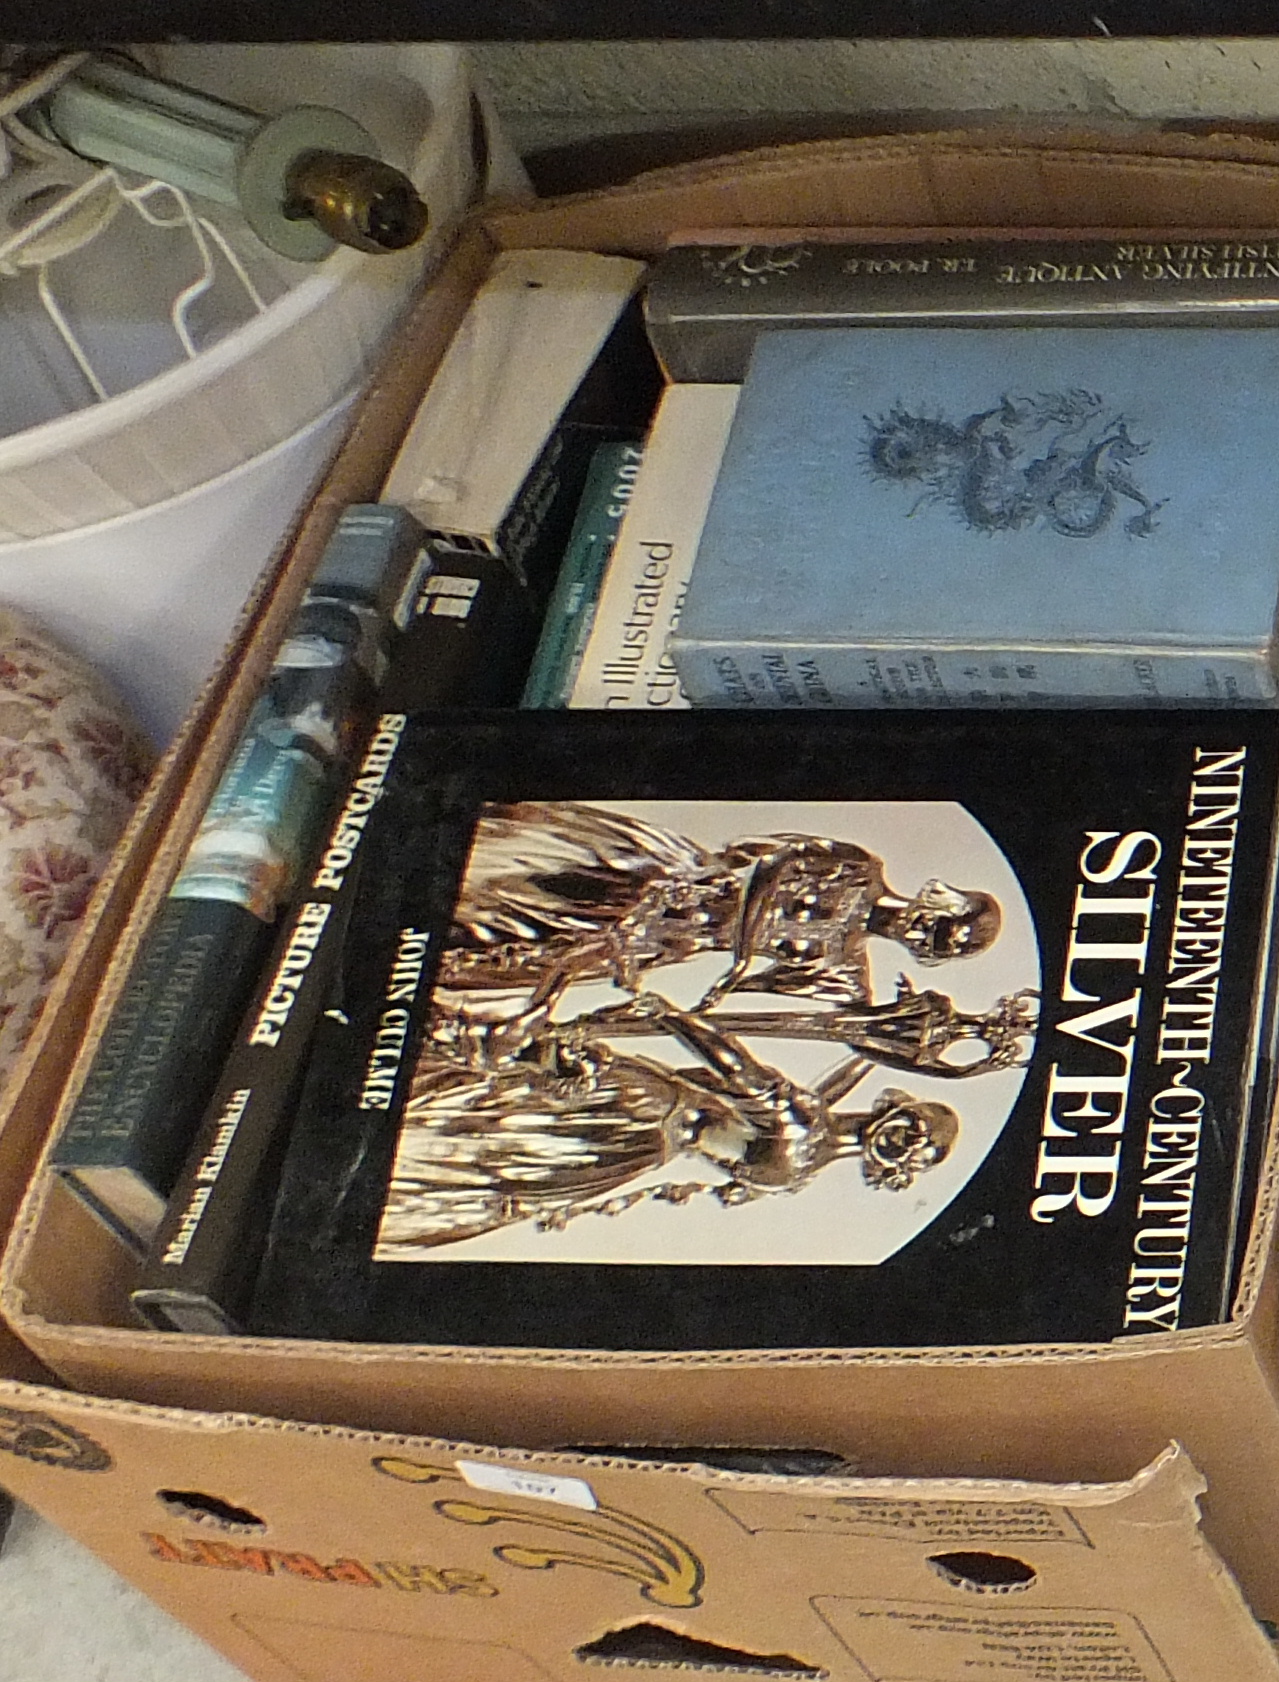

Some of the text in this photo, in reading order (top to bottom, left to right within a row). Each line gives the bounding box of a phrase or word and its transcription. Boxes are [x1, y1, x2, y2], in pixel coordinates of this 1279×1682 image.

[842, 258, 928, 275] POOLE
[995, 261, 1132, 283] ANTIQUE
[1115, 243, 1215, 260] SILVER
[602, 540, 675, 686] Illustrated
[249, 901, 333, 1050] PICTURE
[311, 712, 407, 892] POSTCARDS
[358, 927, 432, 1112] JOHN CULME
[1030, 830, 1164, 1225] SILVER
[162, 1087, 252, 1266] Marian Klamkin
